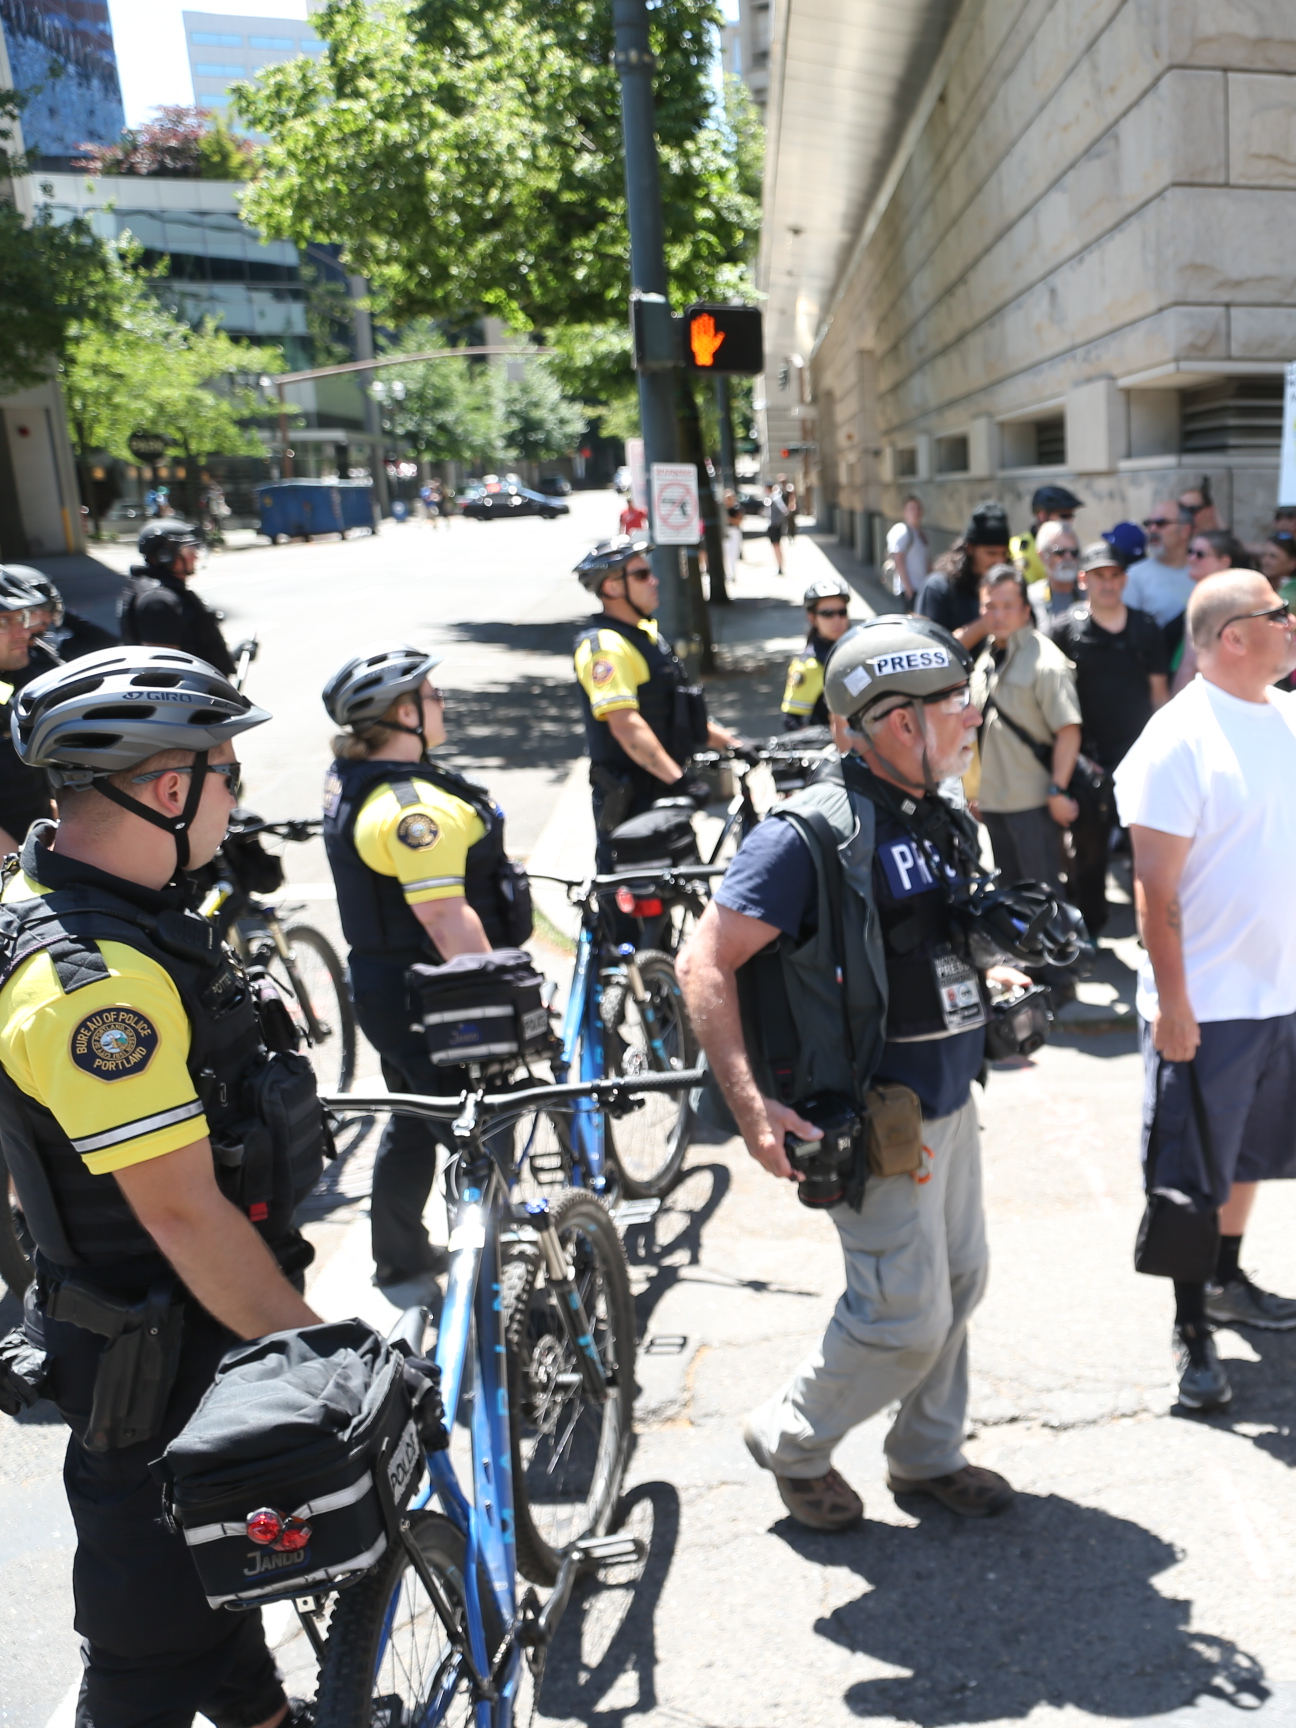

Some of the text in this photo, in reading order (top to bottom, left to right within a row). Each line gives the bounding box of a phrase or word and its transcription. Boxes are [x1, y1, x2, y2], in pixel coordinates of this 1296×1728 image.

[876, 652, 945, 674] PRESS
[146, 690, 192, 703] GIRO
[75, 1011, 152, 1055] BUREAU OF POLICE
[93, 1046, 147, 1071] PORTLAND
